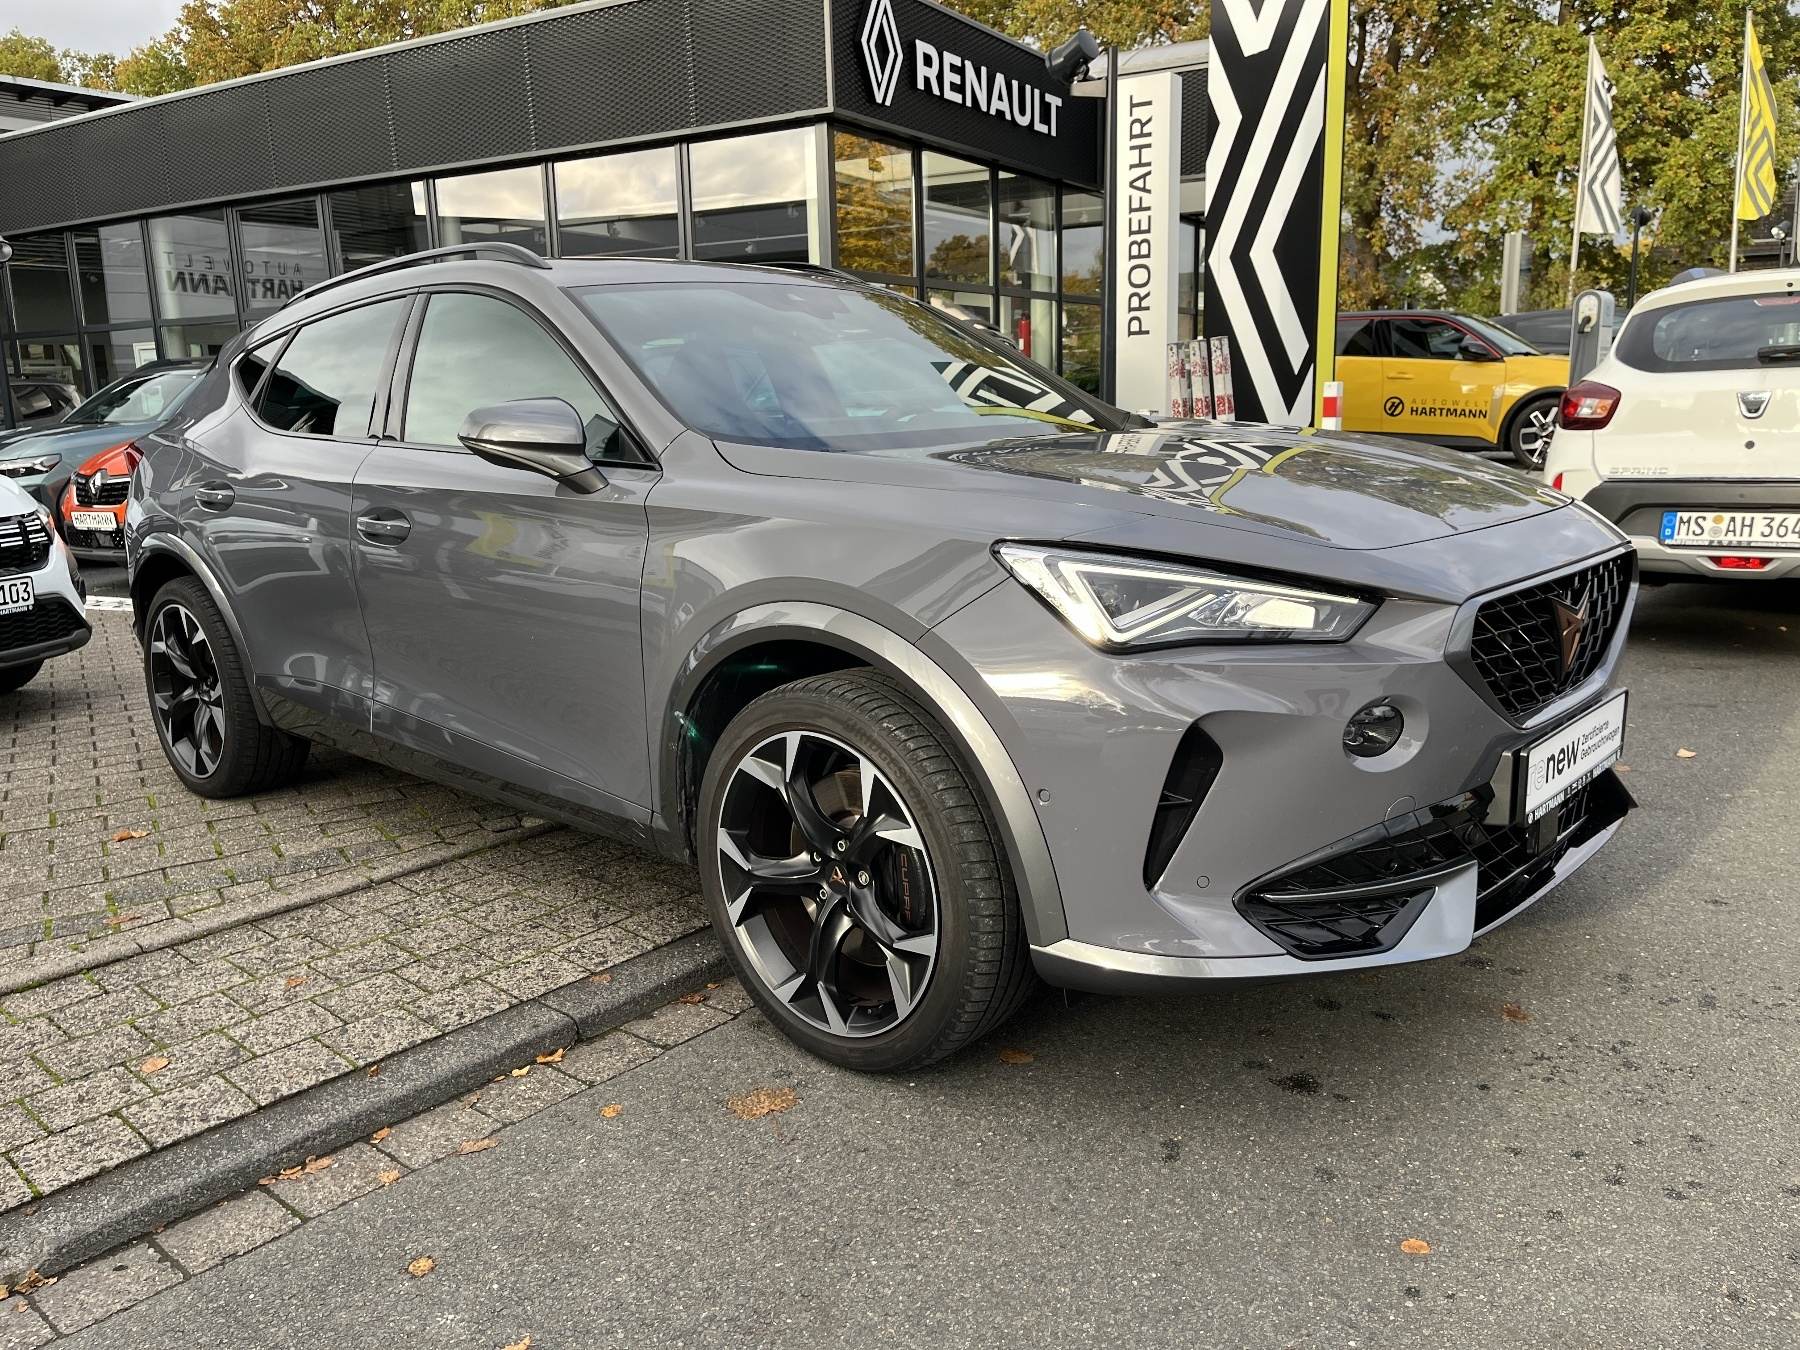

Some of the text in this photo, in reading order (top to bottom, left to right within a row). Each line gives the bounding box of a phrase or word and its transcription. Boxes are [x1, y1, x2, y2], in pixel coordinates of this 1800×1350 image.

[915, 38, 1062, 137] RENAULT
[1127, 95, 1153, 338] PROBEFAHRT
[1410, 406, 1488, 419] HARTMANN
[1411, 398, 1489, 408] AUTOWELT
[1676, 514, 1707, 537] MS
[1724, 515, 1755, 538] AH
